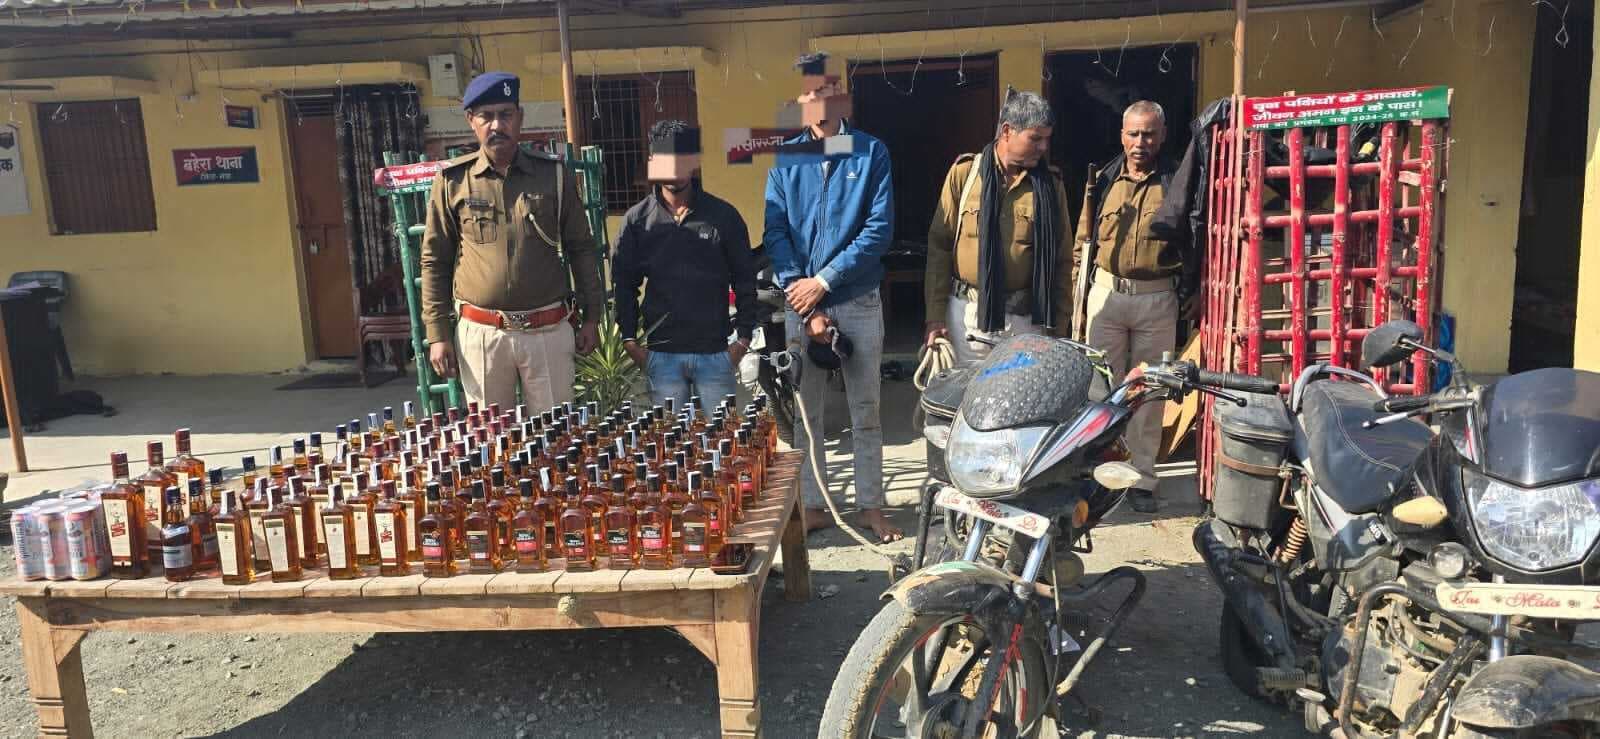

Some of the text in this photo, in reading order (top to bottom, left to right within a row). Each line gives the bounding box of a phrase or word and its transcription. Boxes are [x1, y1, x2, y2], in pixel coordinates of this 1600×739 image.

[1338, 93, 1358, 103] के
[1252, 110, 1296, 121] जीवन
[1367, 102, 1385, 112] के
[183, 151, 244, 174] बहेरा थाना
[1505, 591, 1561, 608] Mata
